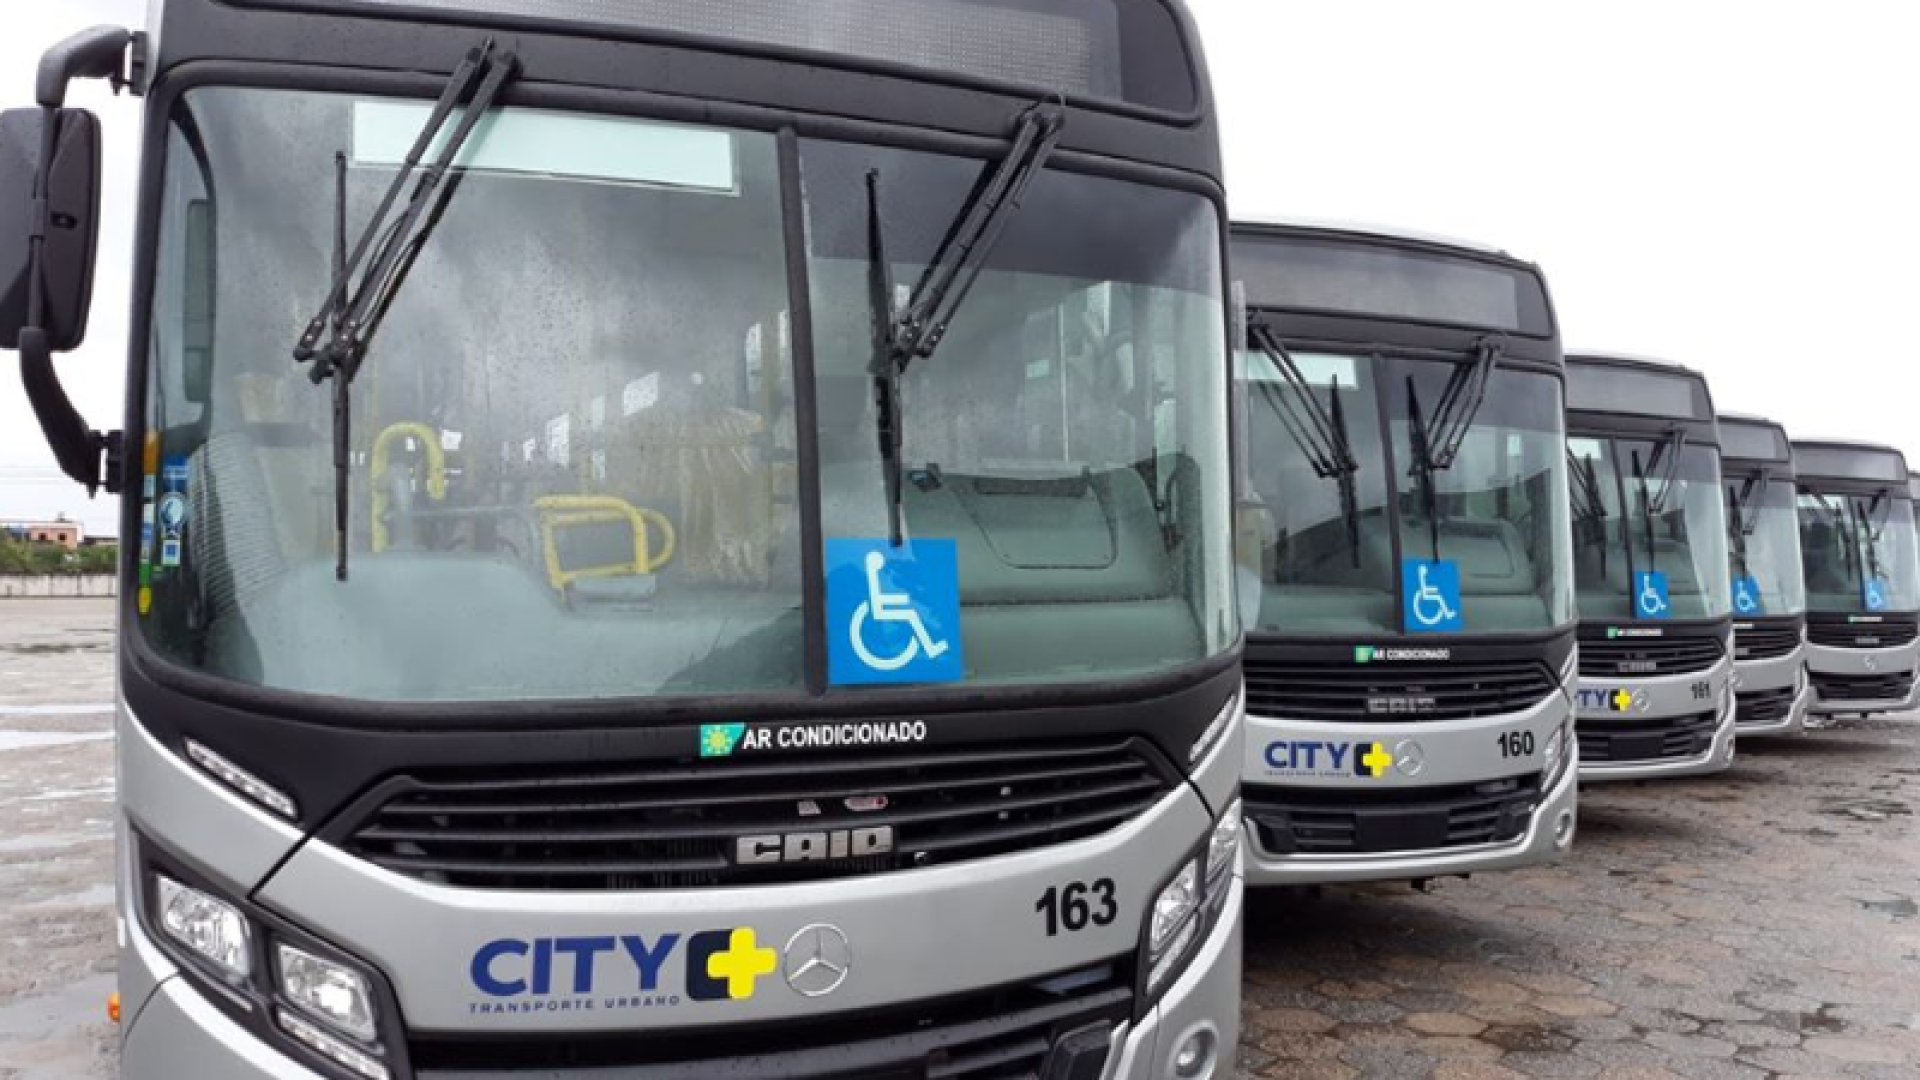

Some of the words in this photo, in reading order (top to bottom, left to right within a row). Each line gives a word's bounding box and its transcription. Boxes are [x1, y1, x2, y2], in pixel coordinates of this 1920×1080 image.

[741, 729, 771, 749] AR
[777, 720, 927, 747] CONDICIONADO
[1497, 731, 1535, 758] 160
[1265, 741, 1349, 769] CITY
[737, 825, 893, 864] CAIO
[1035, 878, 1118, 936] 163
[470, 933, 682, 997] CITY
[470, 999, 595, 1014] TRANSPORTE
[604, 995, 681, 1009] URBANO
